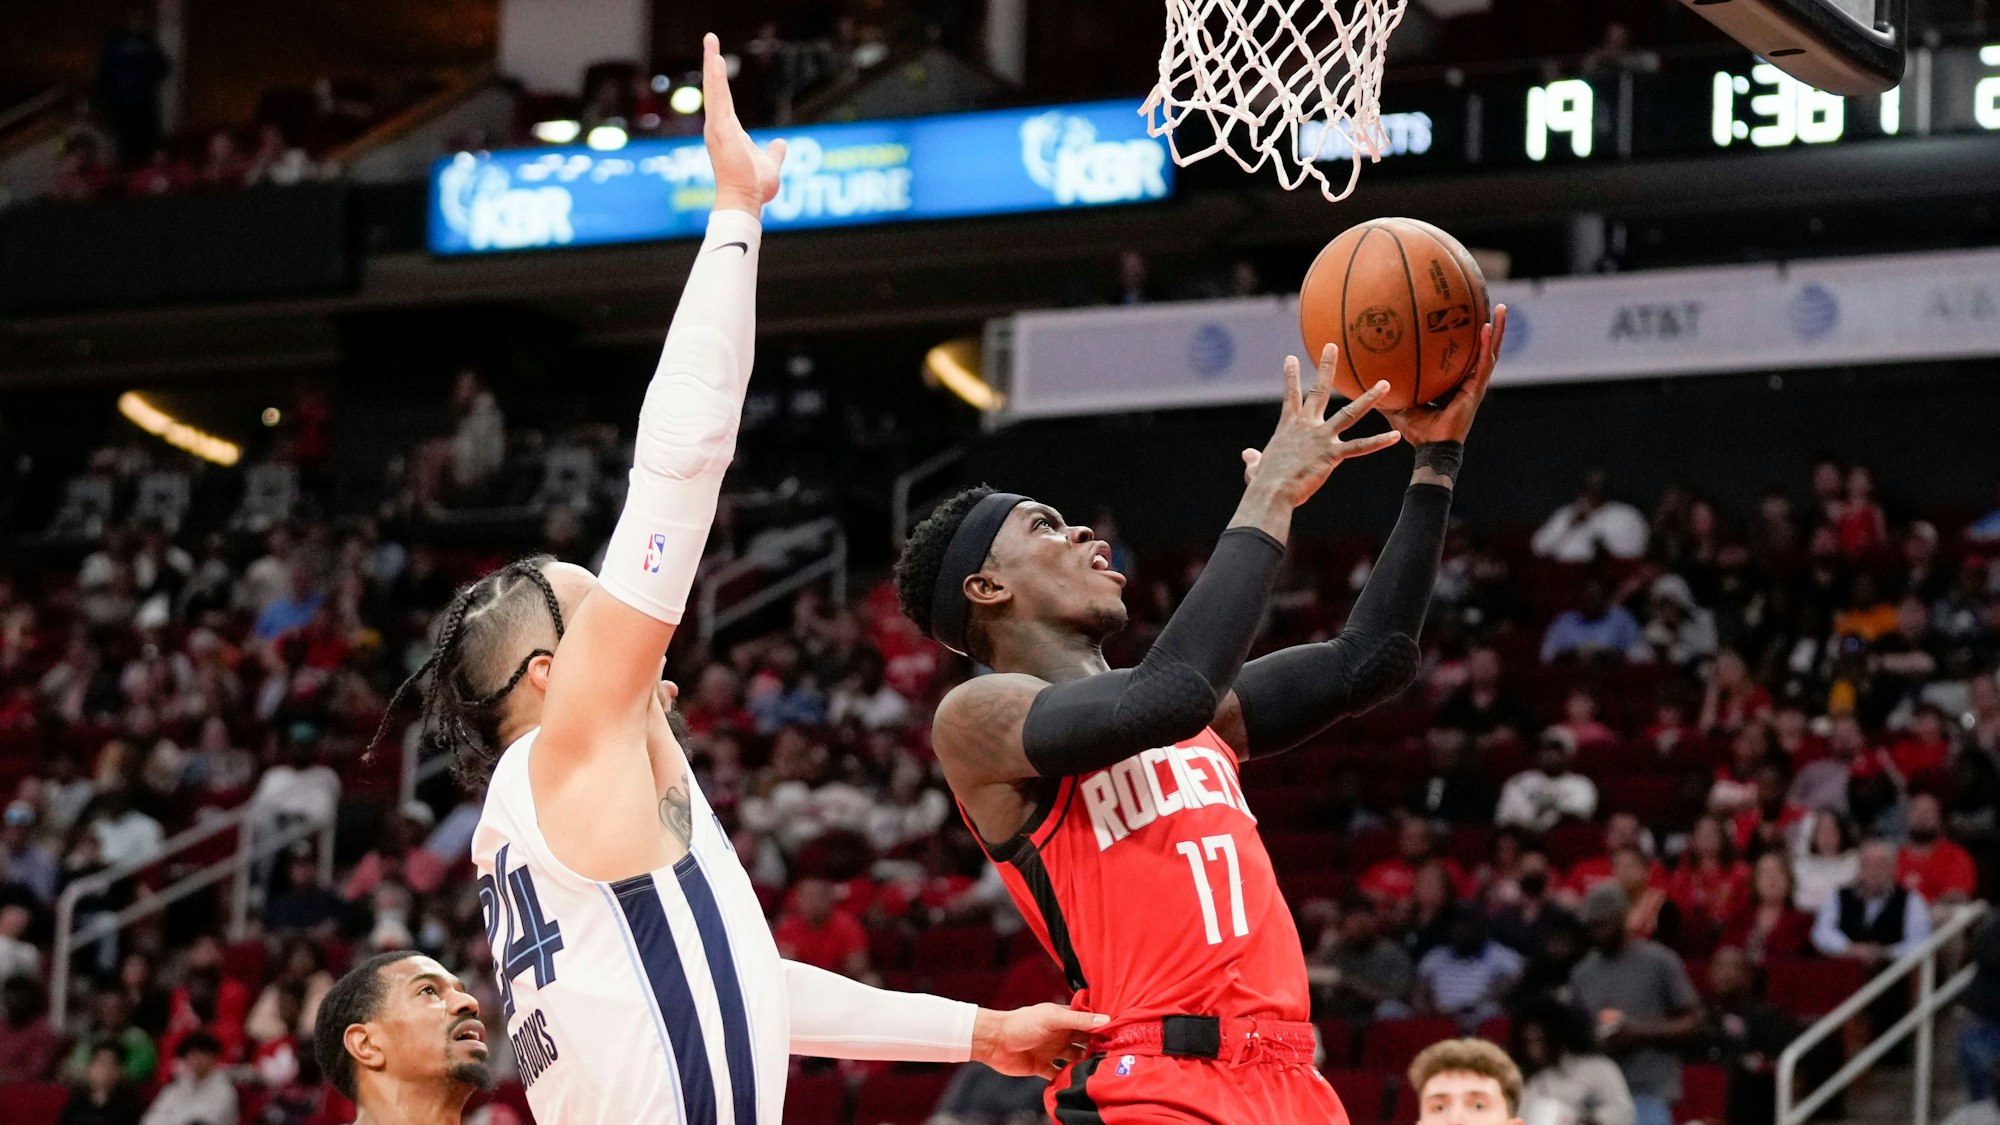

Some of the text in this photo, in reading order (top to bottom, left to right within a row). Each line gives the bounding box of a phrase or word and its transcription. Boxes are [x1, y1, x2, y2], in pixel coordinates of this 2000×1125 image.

[1526, 79, 1595, 161] 19
[766, 167, 913, 222] UTURE
[1080, 745, 1258, 853] ROCKETS
[1175, 833, 1249, 945] 17
